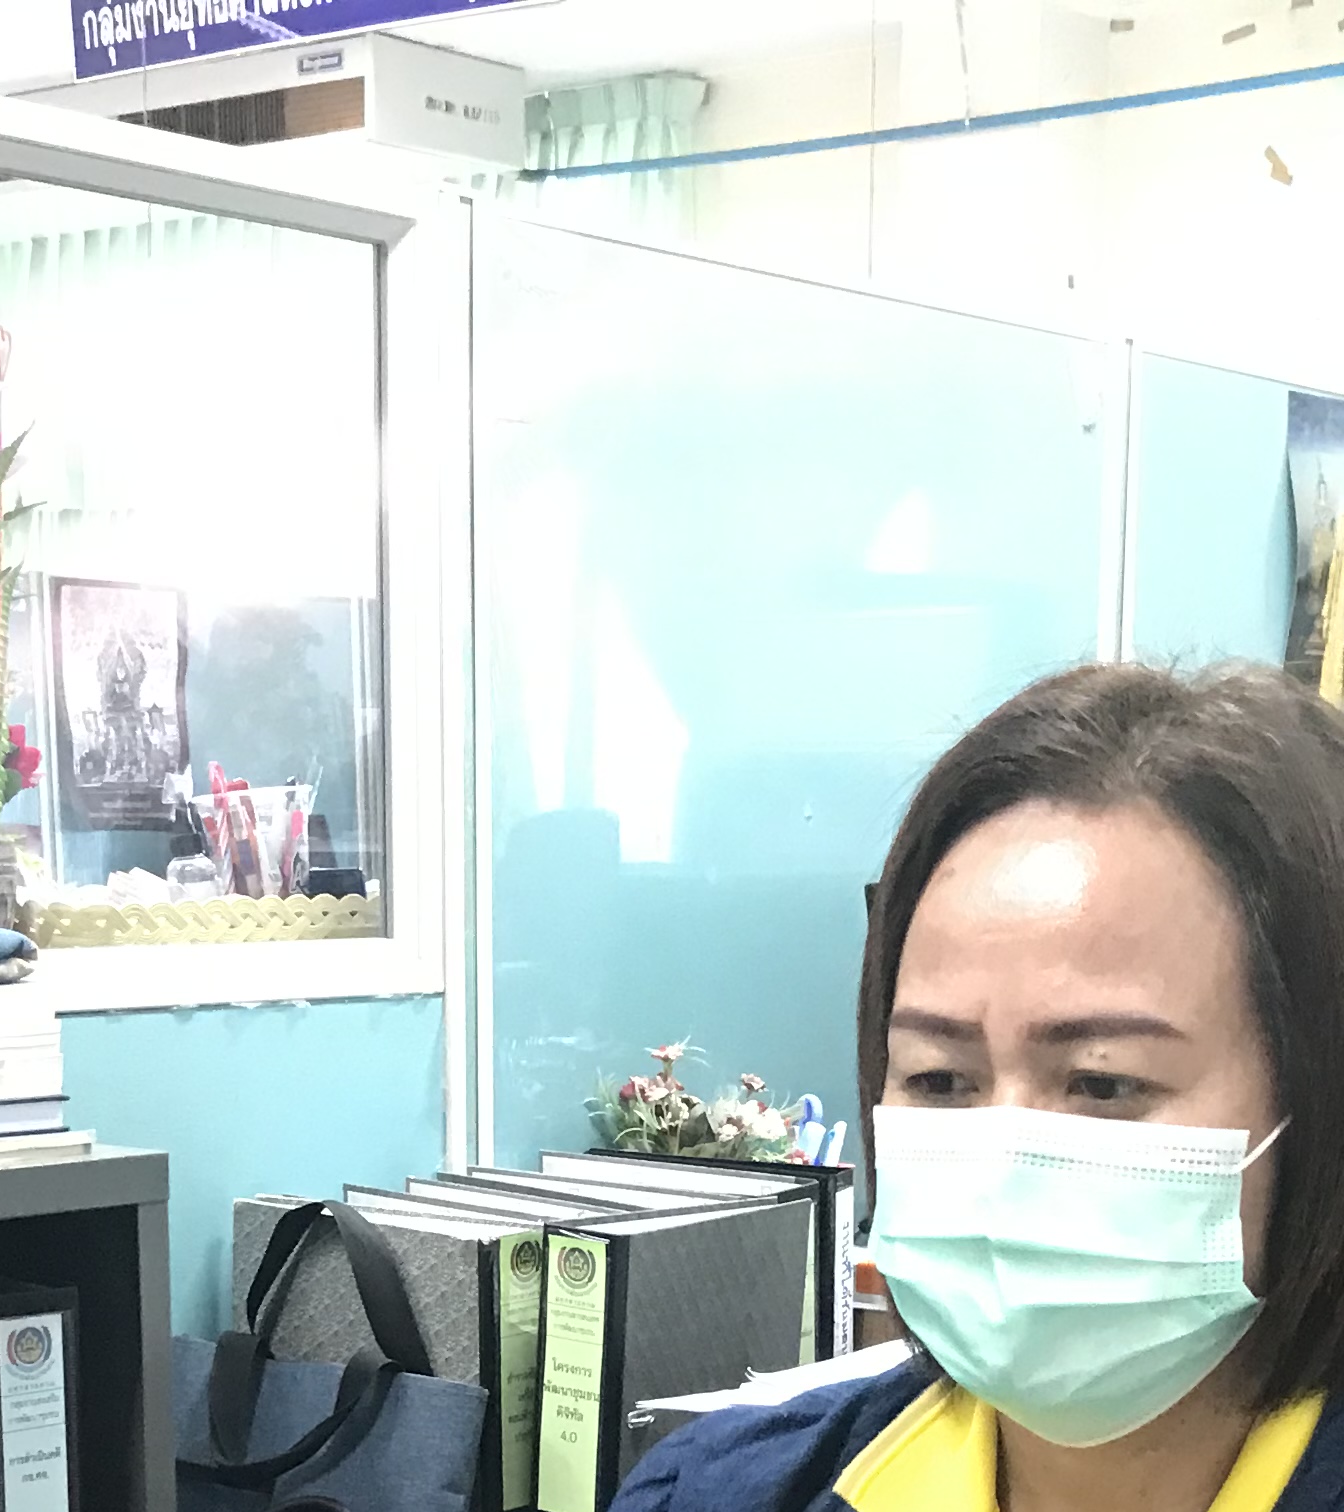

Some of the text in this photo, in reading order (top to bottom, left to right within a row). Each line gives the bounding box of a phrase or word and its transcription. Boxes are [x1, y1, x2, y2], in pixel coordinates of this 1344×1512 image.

[551, 1356, 593, 1378] โครงการ
[560, 1430, 578, 1444] 4.0
